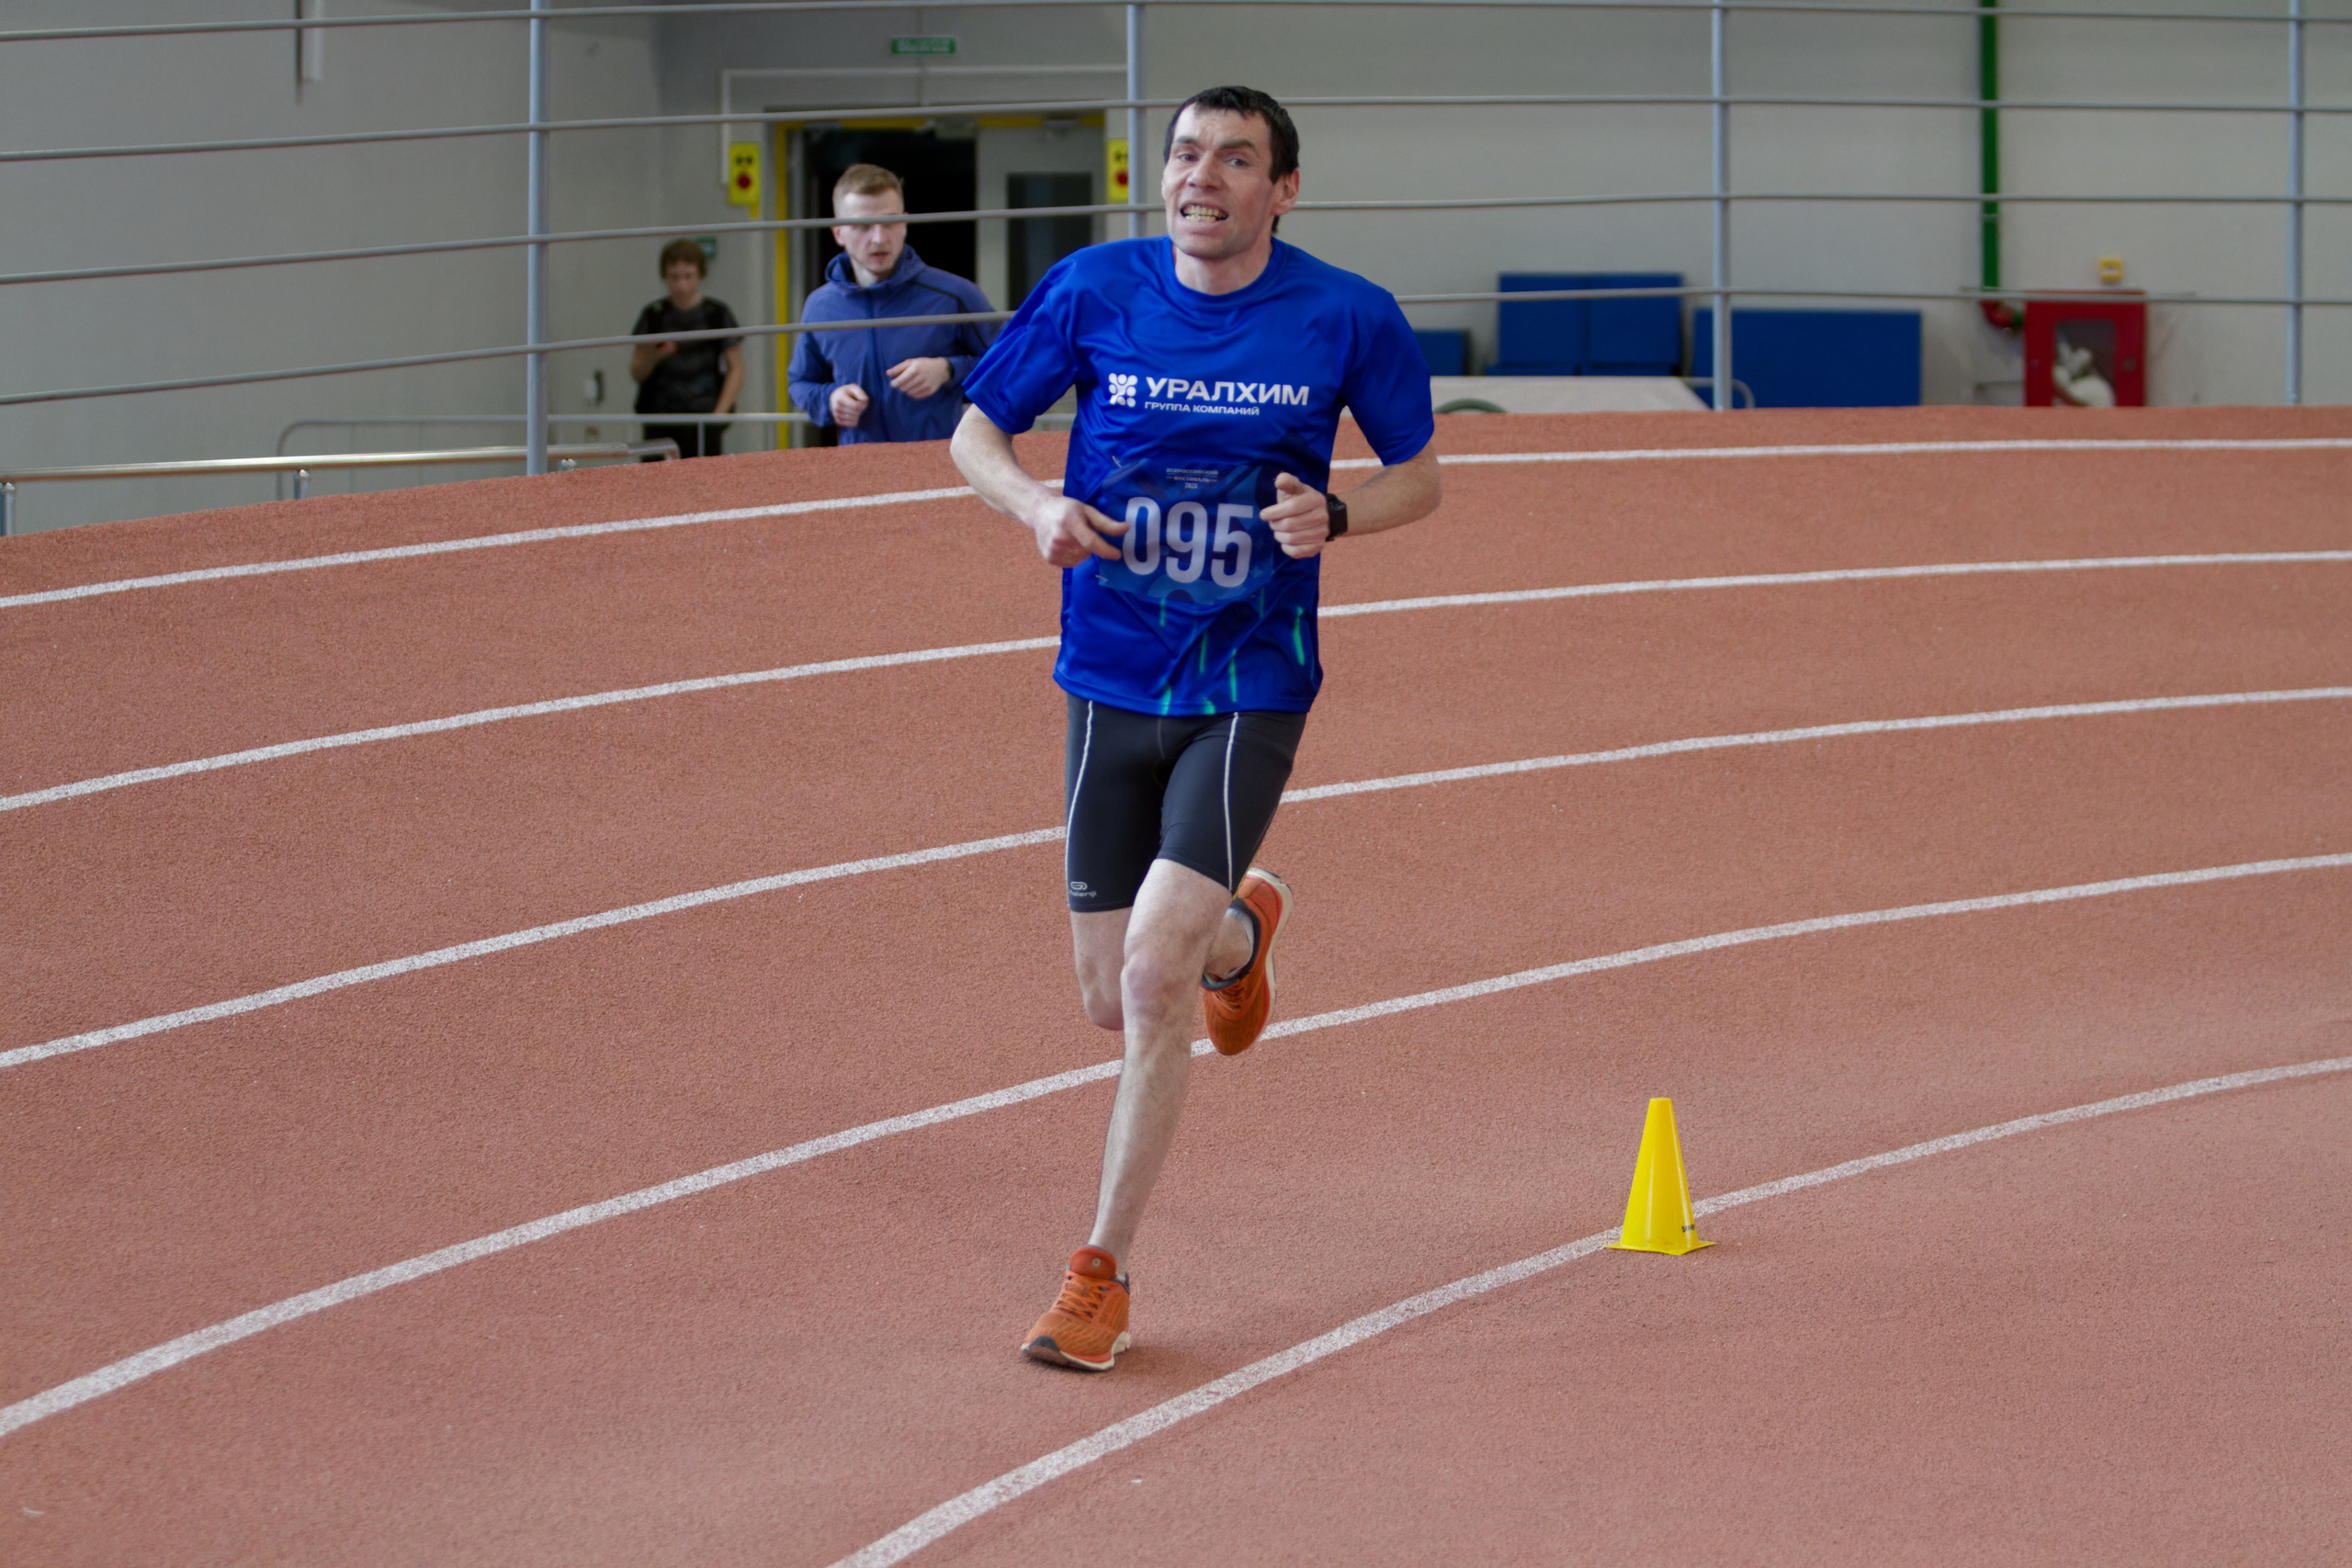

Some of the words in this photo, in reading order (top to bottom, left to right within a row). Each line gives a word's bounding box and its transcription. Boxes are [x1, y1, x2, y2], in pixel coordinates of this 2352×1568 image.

[1146, 377, 1309, 406] УРАЛХИМ
[1145, 401, 1191, 412] ГРУППА
[1193, 404, 1260, 416] КОМПАНИЙ
[1122, 496, 1254, 587] 095
